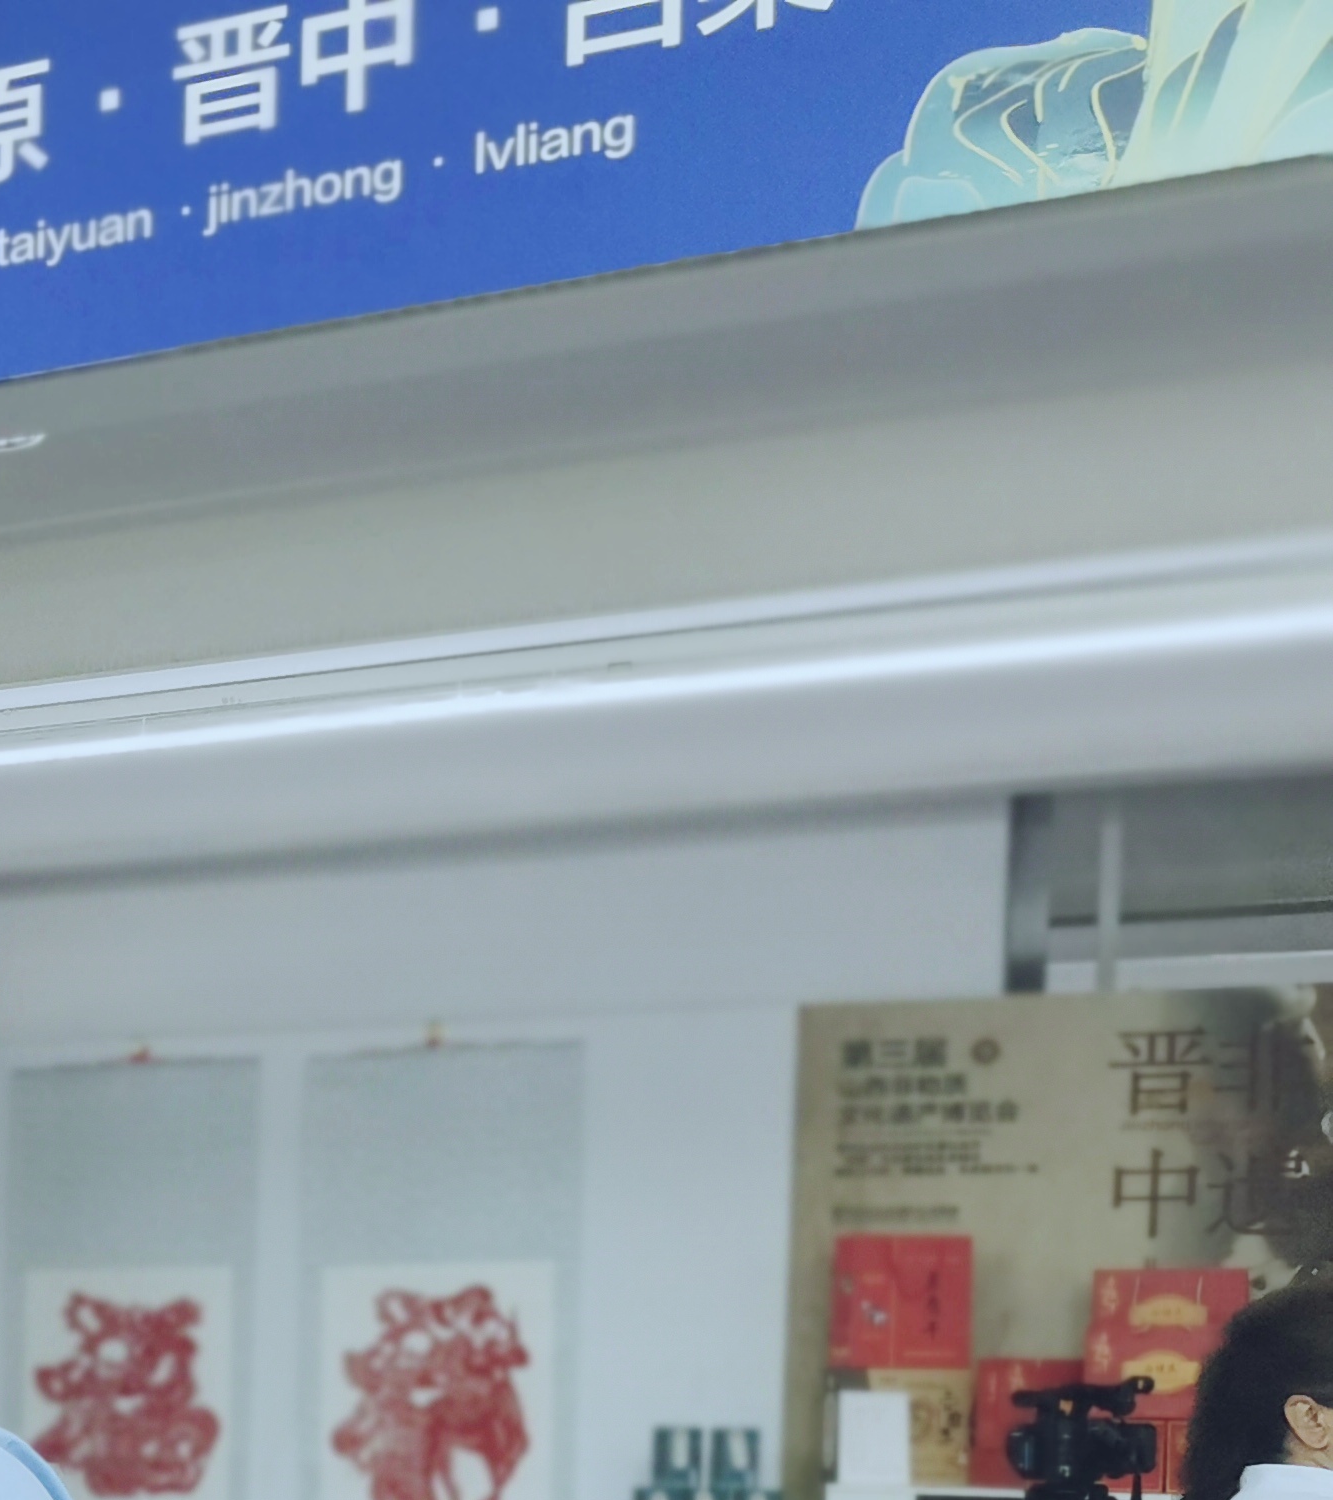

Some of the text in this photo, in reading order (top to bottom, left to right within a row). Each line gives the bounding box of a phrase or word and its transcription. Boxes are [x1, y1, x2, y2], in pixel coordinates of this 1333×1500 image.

[203, 161, 403, 237] jinzhong
[475, 114, 634, 174] lvliang
[1108, 1027, 1213, 1238] 晋中
